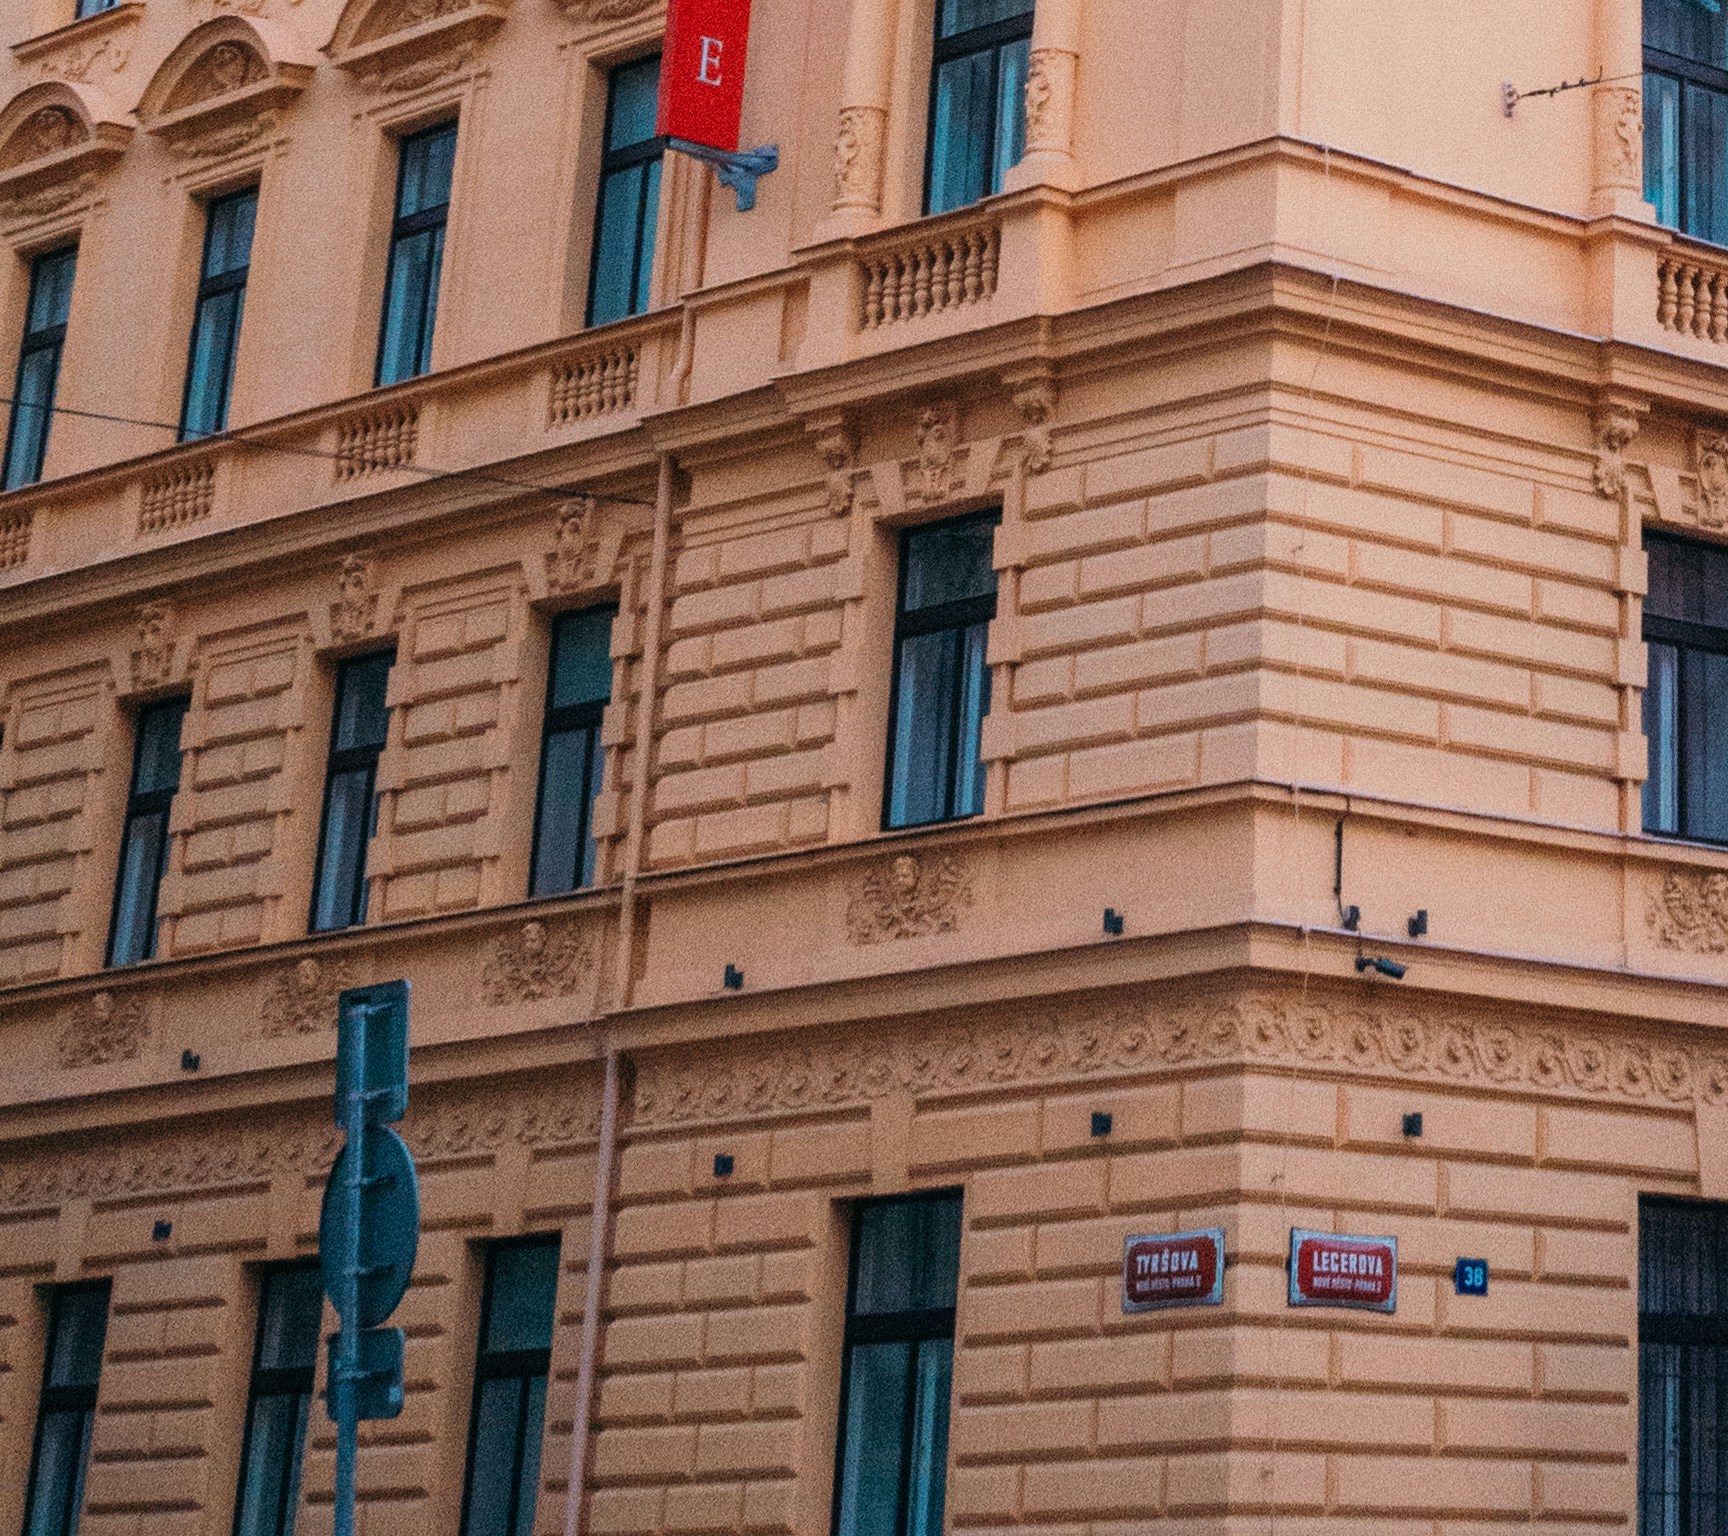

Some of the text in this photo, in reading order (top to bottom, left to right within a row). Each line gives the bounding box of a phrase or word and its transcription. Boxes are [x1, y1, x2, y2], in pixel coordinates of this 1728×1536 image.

[1136, 1248, 1198, 1275] TYRŠOVA
[1313, 1250, 1383, 1276] LEGEROVA
[1464, 1266, 1484, 1287] 38
